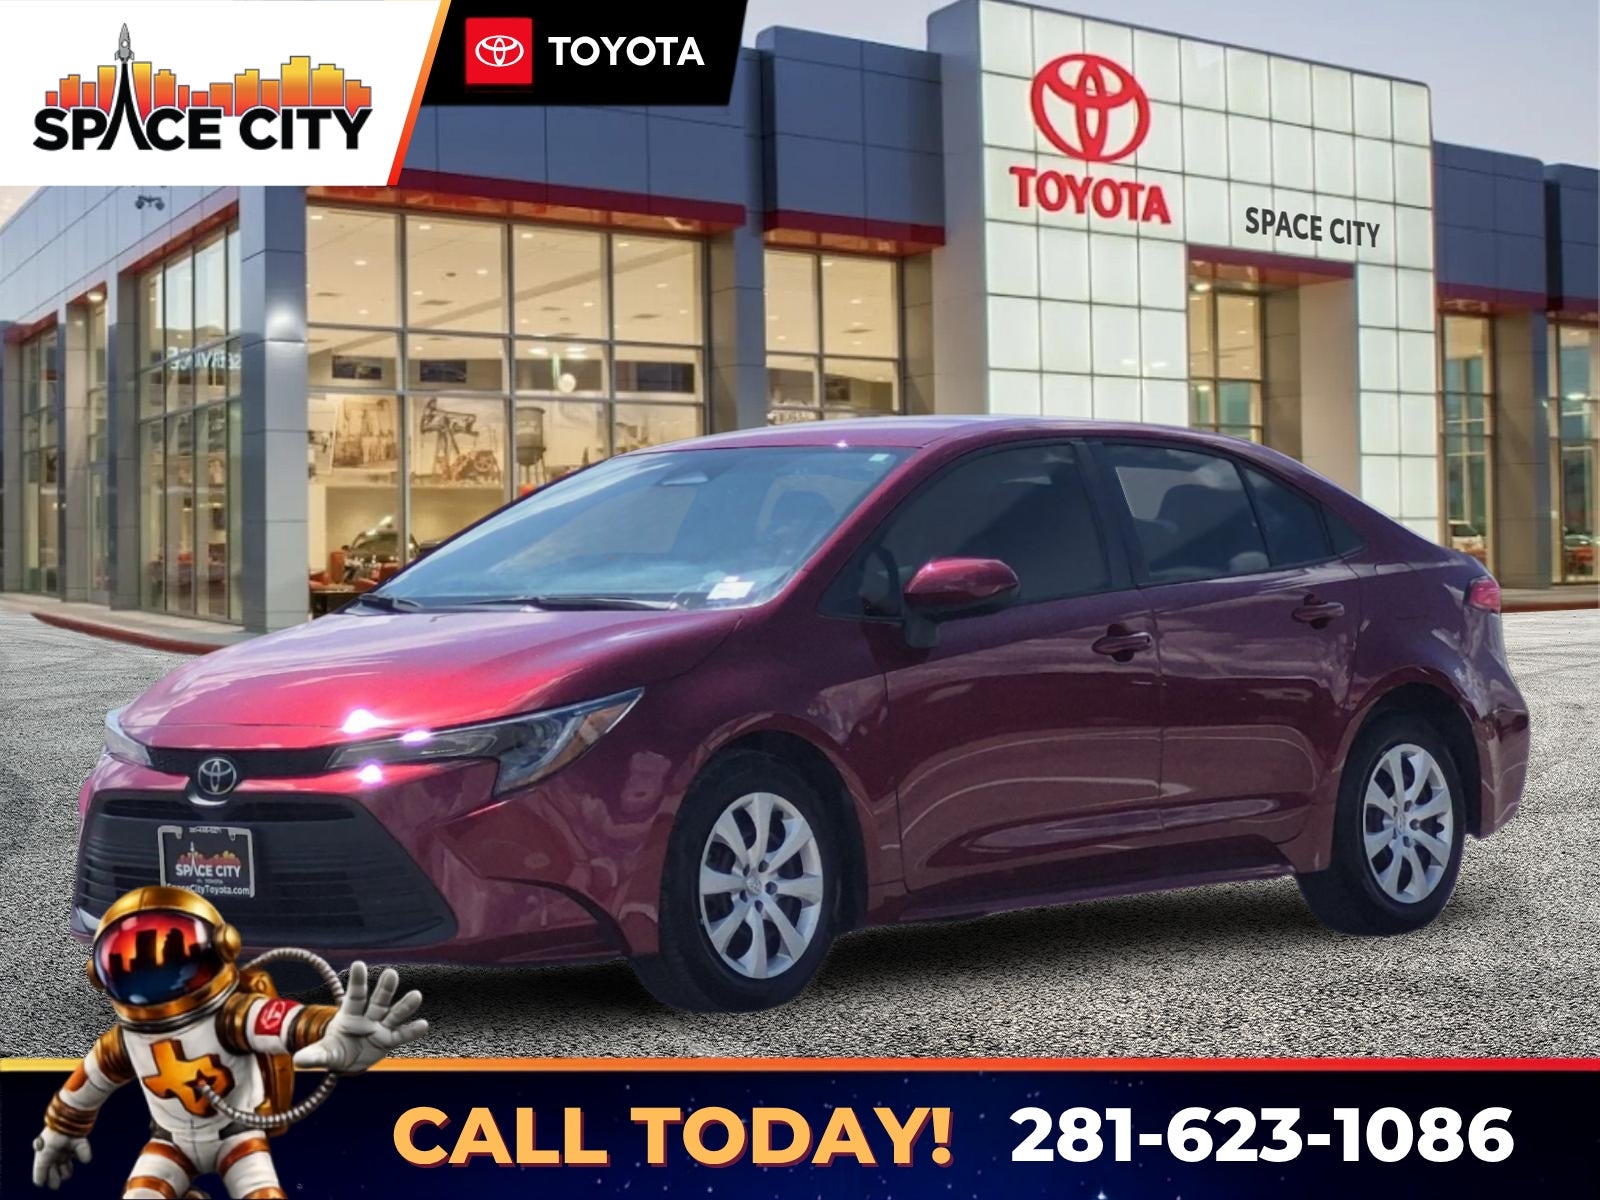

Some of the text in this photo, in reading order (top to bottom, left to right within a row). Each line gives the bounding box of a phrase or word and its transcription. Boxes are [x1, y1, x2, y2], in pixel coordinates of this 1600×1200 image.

[1009, 166, 1171, 224] TOYOTA
[1245, 206, 1380, 248] SPACE CITY
[175, 863, 241, 878] SPACE CITY
[167, 883, 250, 895] CityToyota.com
